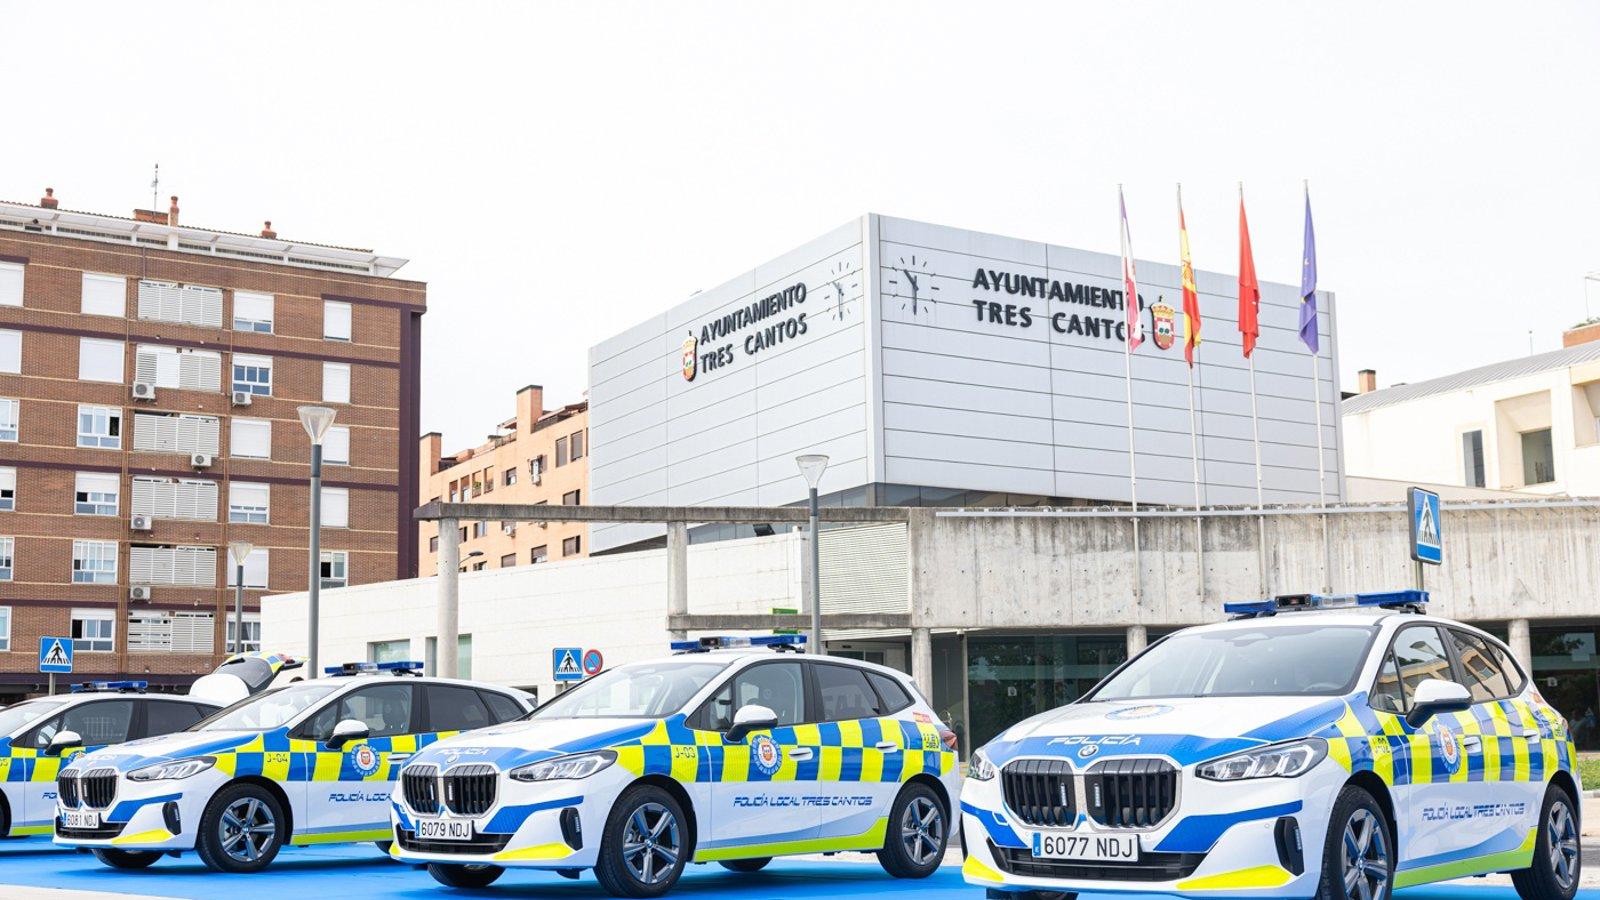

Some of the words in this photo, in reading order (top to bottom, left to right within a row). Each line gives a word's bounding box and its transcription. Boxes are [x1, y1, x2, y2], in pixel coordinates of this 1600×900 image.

[700, 282, 807, 346] AYUNTAMIENTO
[973, 299, 1032, 328] TRES
[700, 343, 734, 374] TRES
[744, 312, 808, 356] CANTOS
[1047, 733, 1142, 746] POLICÍA
[366, 793, 392, 802] LOCA
[769, 796, 800, 807] LOCAL
[801, 796, 831, 806] TRES
[831, 796, 873, 806] CANTOS
[421, 822, 446, 837] 6079
[448, 823, 470, 838] NDJ
[1044, 836, 1090, 856] 6077
[1097, 838, 1133, 858] NDJ
